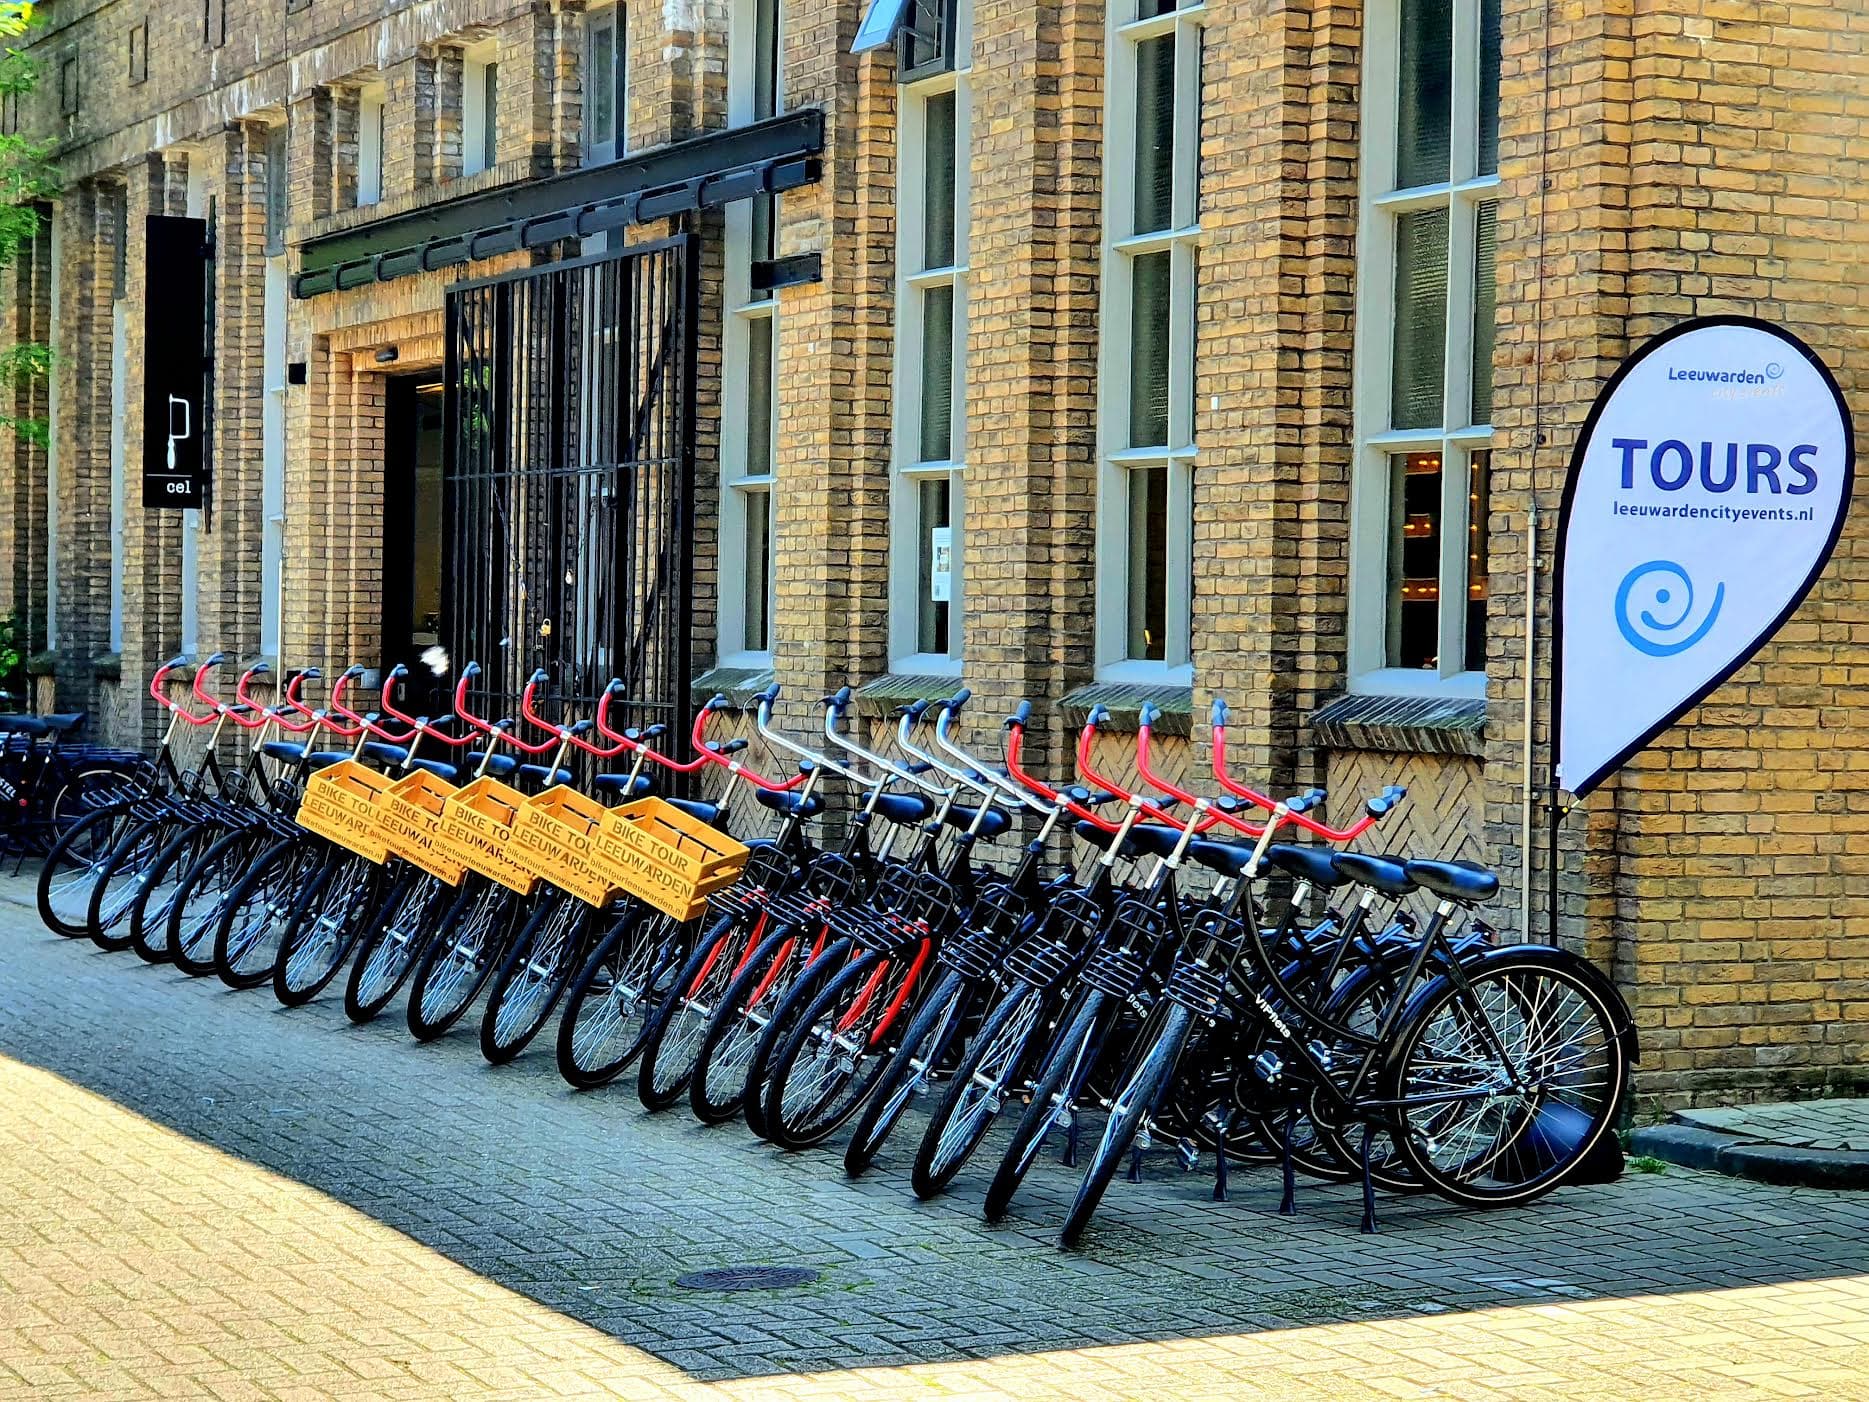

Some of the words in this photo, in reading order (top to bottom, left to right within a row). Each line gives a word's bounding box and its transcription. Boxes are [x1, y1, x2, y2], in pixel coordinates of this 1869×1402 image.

[1668, 367, 1765, 385] Leeuwarden
[166, 480, 191, 494] cel
[1611, 438, 1819, 495] TOURS
[1613, 500, 1814, 522] leeuwardencityevents.nl
[317, 783, 347, 804] BIKE
[390, 799, 419, 823] BIKE
[299, 814, 383, 861] biketourleeuwarden.nl
[454, 806, 485, 831] BIKE
[491, 825, 510, 842] TO
[529, 812, 563, 839] BIKE
[567, 831, 595, 856] TOU
[612, 820, 646, 848] BIKE
[650, 841, 689, 873] TOUR
[369, 831, 456, 883] biketourleeuwarden.nl
[434, 840, 526, 890] biketourleeuwarden.nl
[506, 846, 600, 903] biketourleeuwarden.nl
[595, 835, 693, 899] LEEUWARDEN
[590, 858, 684, 916] biketourleeuwarden.nl
